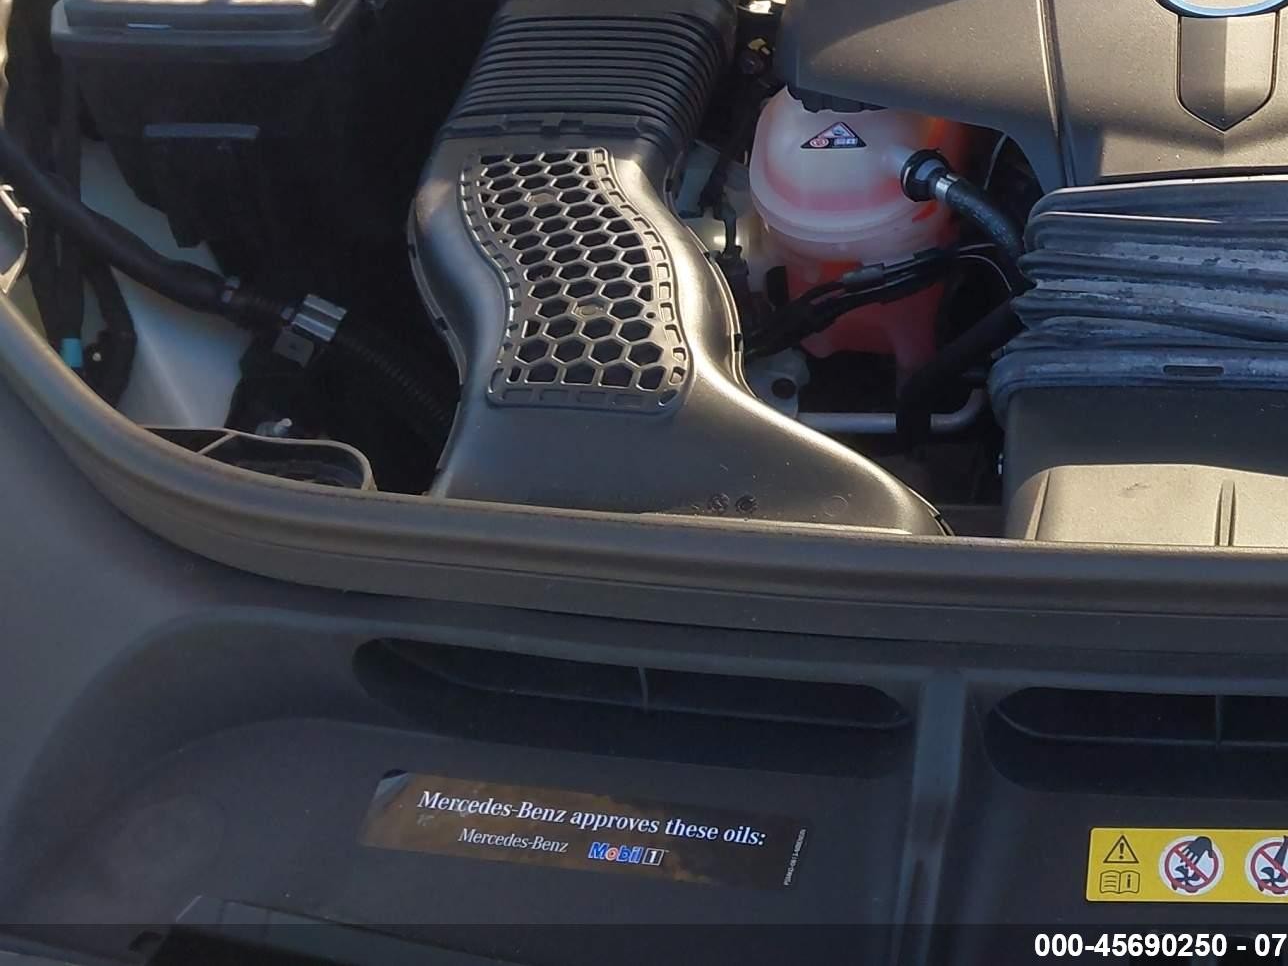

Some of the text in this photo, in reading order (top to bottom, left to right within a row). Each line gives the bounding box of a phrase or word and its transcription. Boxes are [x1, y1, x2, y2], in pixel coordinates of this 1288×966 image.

[417, 790, 767, 846] Mercedes-Benz approves these oils:
[458, 828, 569, 853] Mercedes-Benz
[587, 841, 644, 864] Mobil
